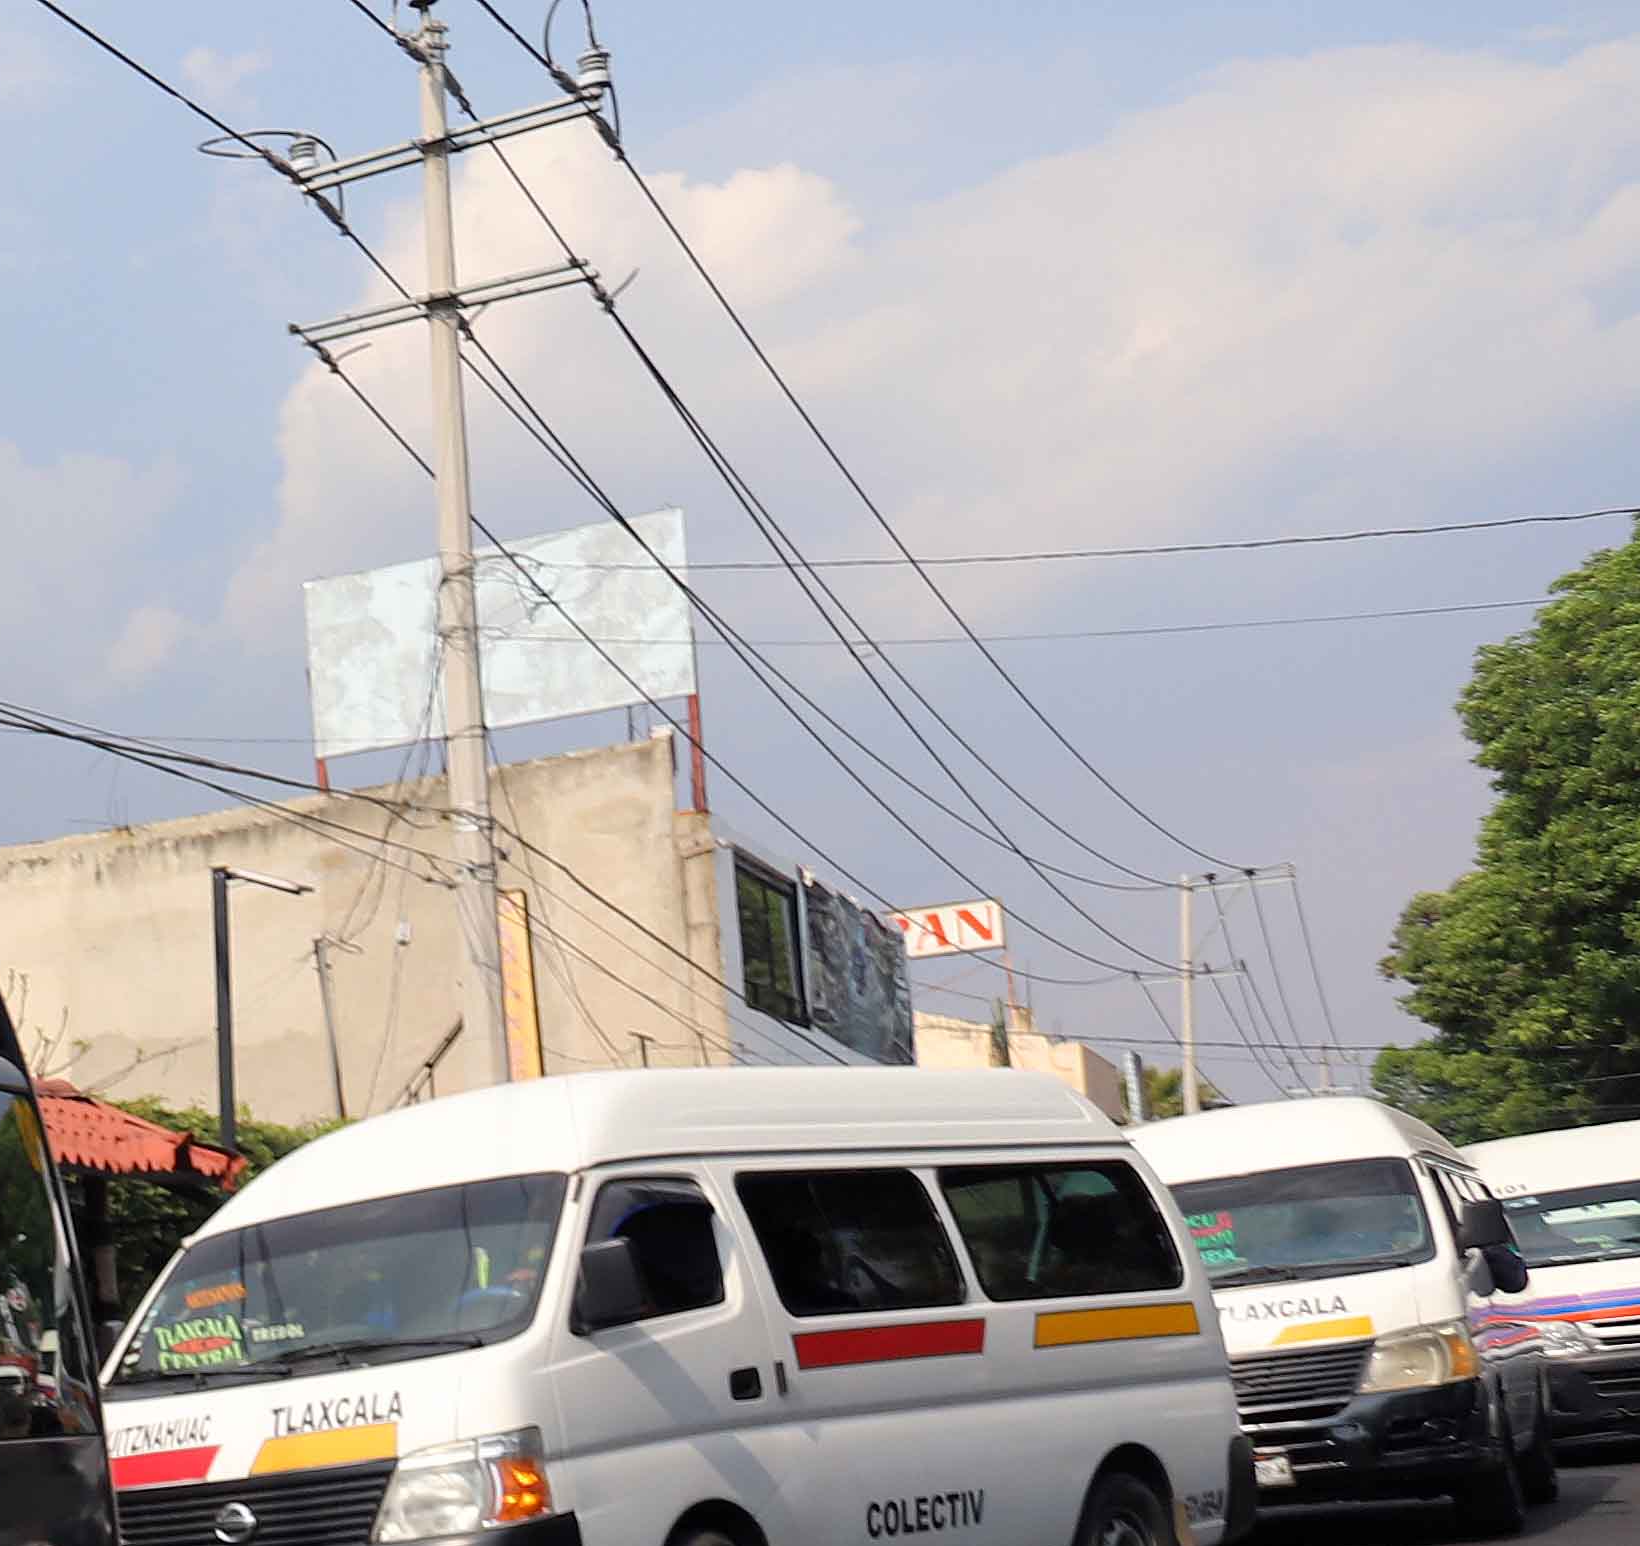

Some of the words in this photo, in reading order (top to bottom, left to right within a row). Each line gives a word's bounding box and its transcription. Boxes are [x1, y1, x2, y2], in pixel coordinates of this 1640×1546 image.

[153, 1314, 243, 1351] TLAXCALA
[271, 1390, 404, 1438] TLAXCALA
[866, 1487, 985, 1539] COLECTIV
